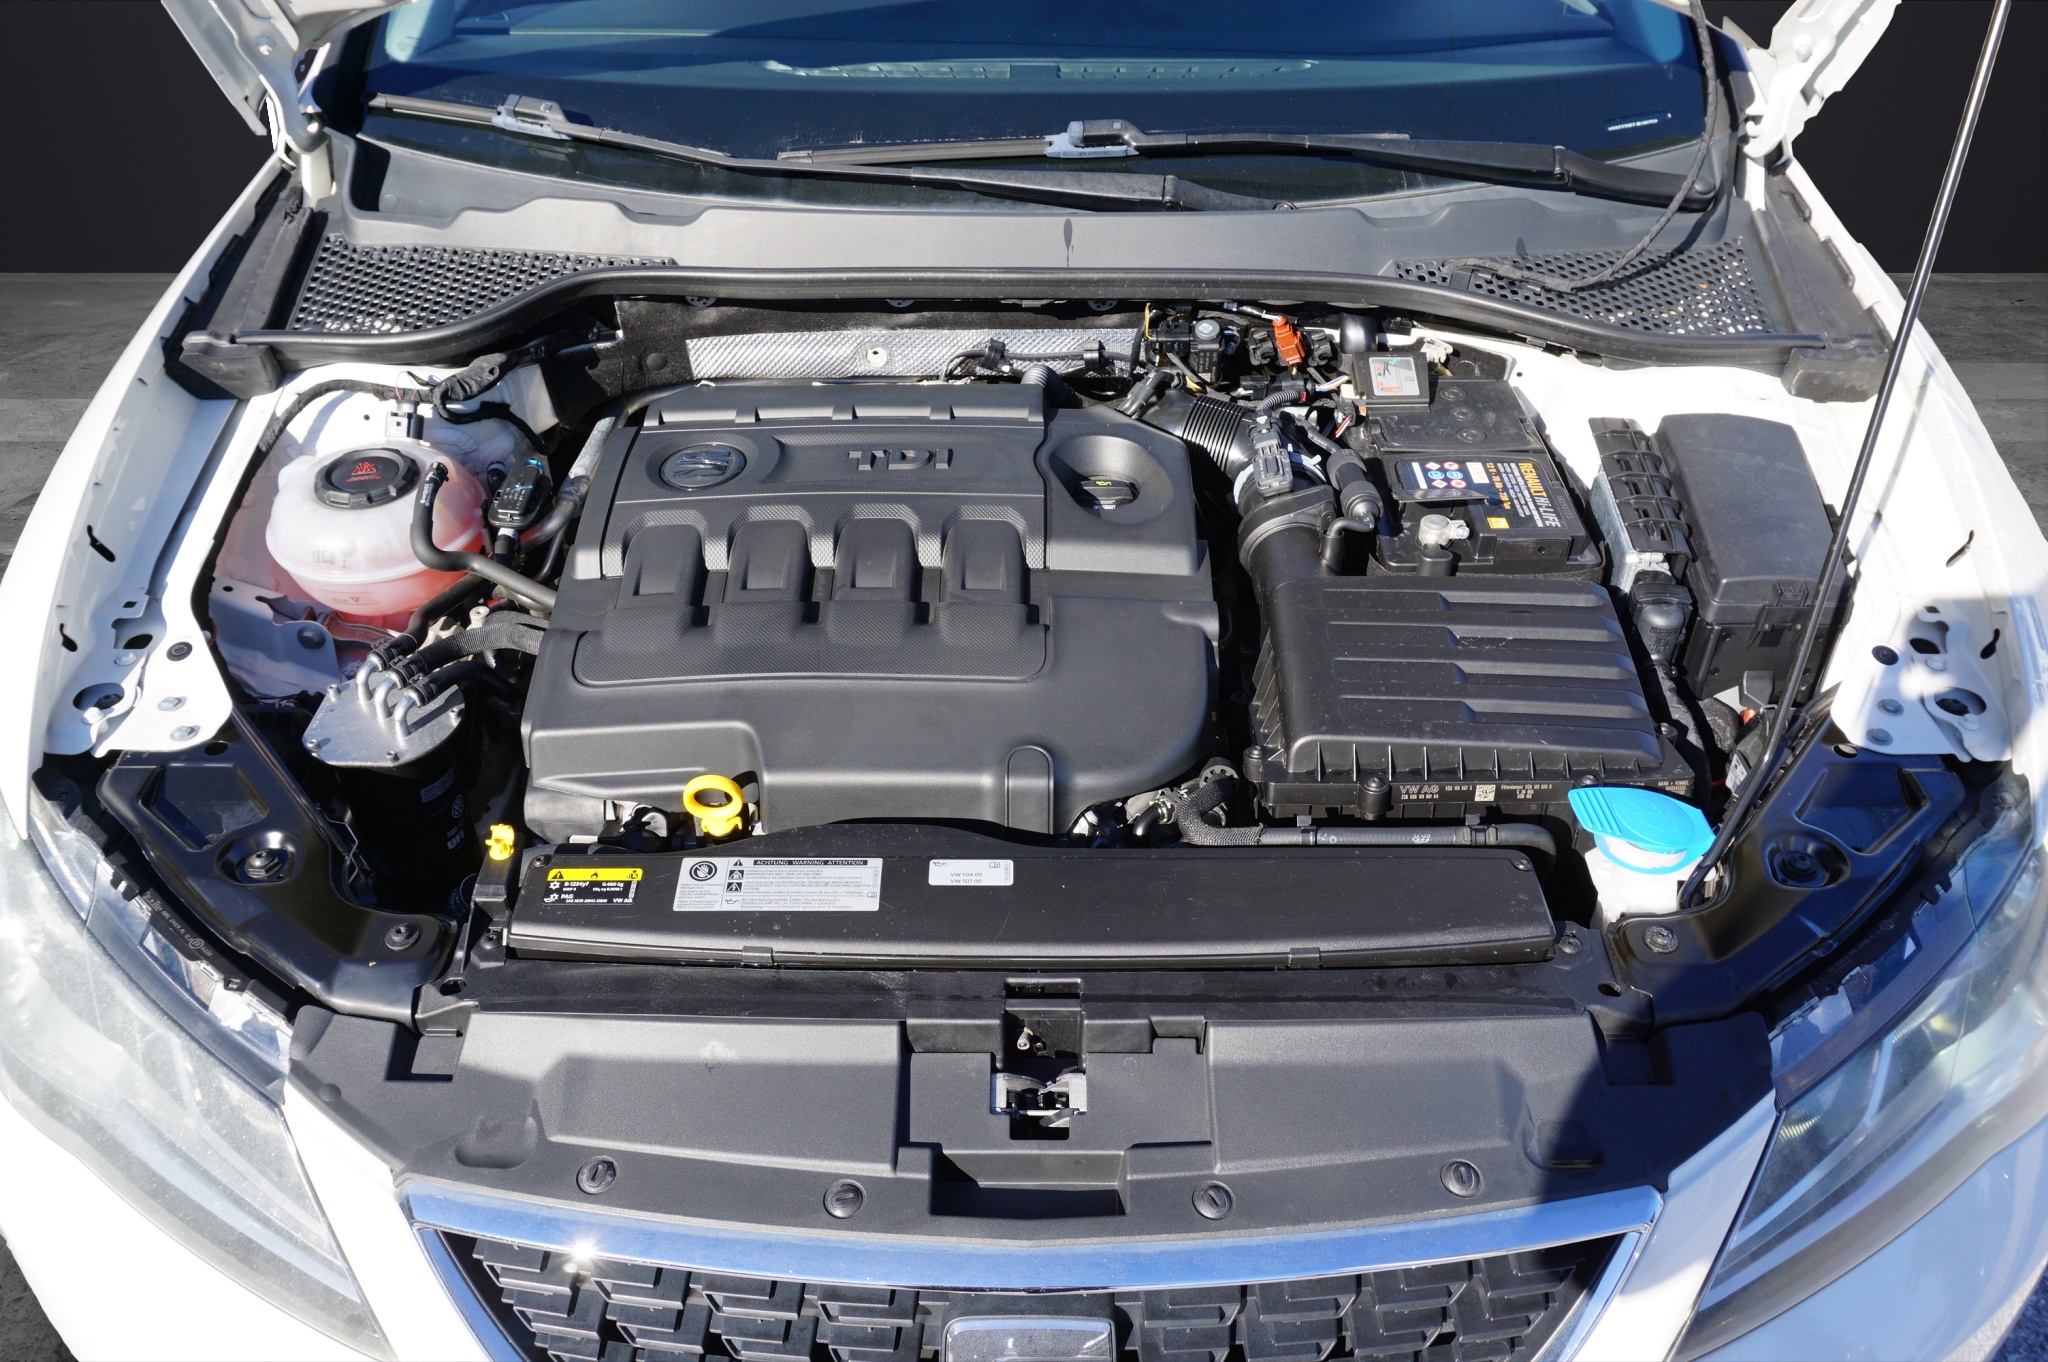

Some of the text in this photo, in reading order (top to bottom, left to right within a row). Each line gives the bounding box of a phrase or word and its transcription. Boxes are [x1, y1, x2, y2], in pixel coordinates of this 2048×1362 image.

[847, 448, 953, 471] TDI
[1518, 462, 1548, 497] RENAULT
[1534, 496, 1562, 527] Hi-LIFE
[1400, 785, 1439, 794] VW AG
